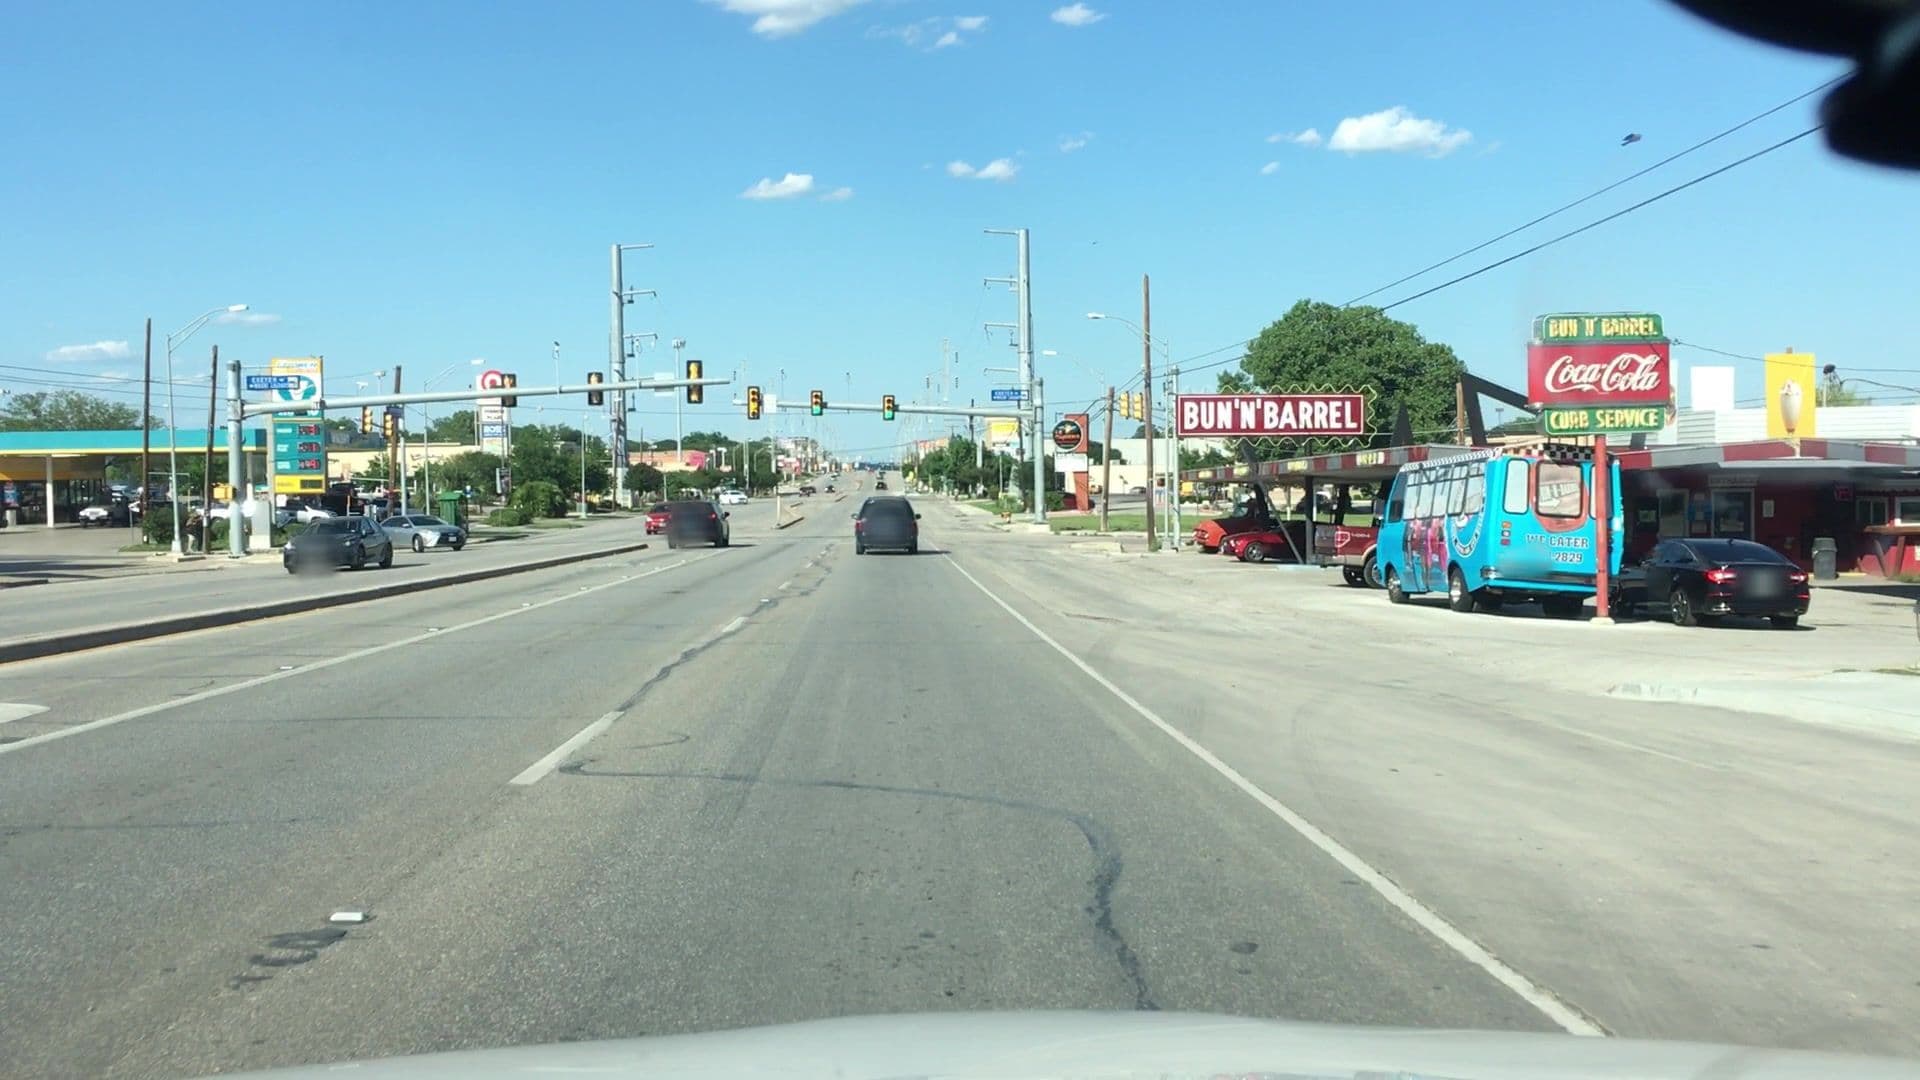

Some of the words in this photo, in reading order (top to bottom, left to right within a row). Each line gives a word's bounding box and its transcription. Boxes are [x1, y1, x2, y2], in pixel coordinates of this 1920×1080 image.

[1549, 318, 1578, 337] BUN
[1601, 317, 1658, 337] BARREL
[1545, 353, 1661, 394] Coca-Cola
[1550, 410, 1589, 429] CURB
[1595, 408, 1659, 428] SERVICE
[1549, 536, 1589, 548] CATER
